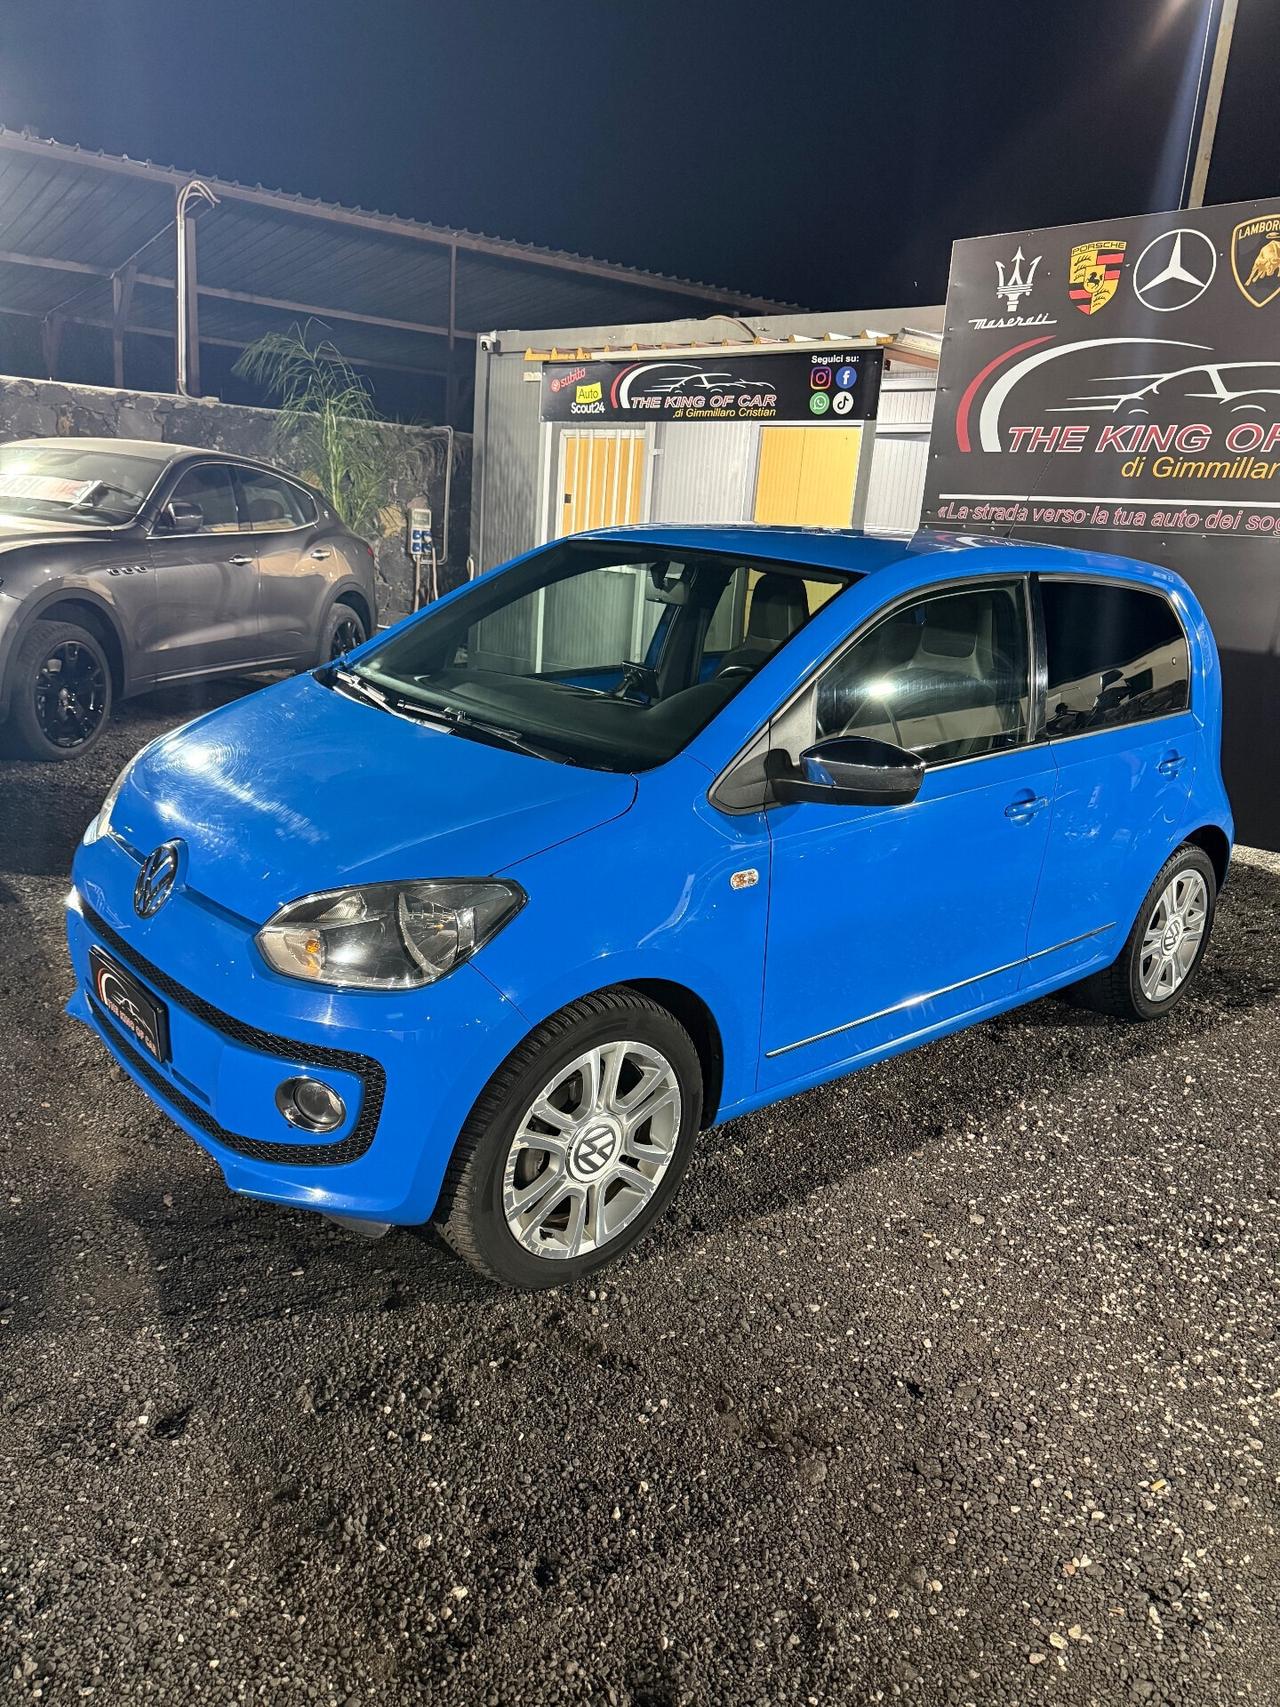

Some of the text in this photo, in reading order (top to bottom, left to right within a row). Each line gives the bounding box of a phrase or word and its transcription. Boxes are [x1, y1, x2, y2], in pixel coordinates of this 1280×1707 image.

[1238, 220, 1280, 240] LAMBOR
[1072, 241, 1125, 255] PORSCHE
[968, 313, 1057, 330] Maserati
[811, 354, 860, 365] Seguici su:
[560, 367, 586, 388] subito
[578, 389, 598, 399] Auto
[631, 394, 778, 409] THE KING OF CAR
[571, 401, 605, 414] Scout24
[738, 407, 776, 417] Cristian
[1008, 426, 1090, 453] THE
[1095, 424, 1213, 453] KING
[1121, 456, 1147, 478] di
[972, 503, 1028, 521] strada
[1032, 508, 1085, 524] verso
[1090, 505, 1109, 525] la
[1113, 507, 1146, 526] tua
[1151, 508, 1200, 529] auto
[1204, 509, 1243, 530] dei
